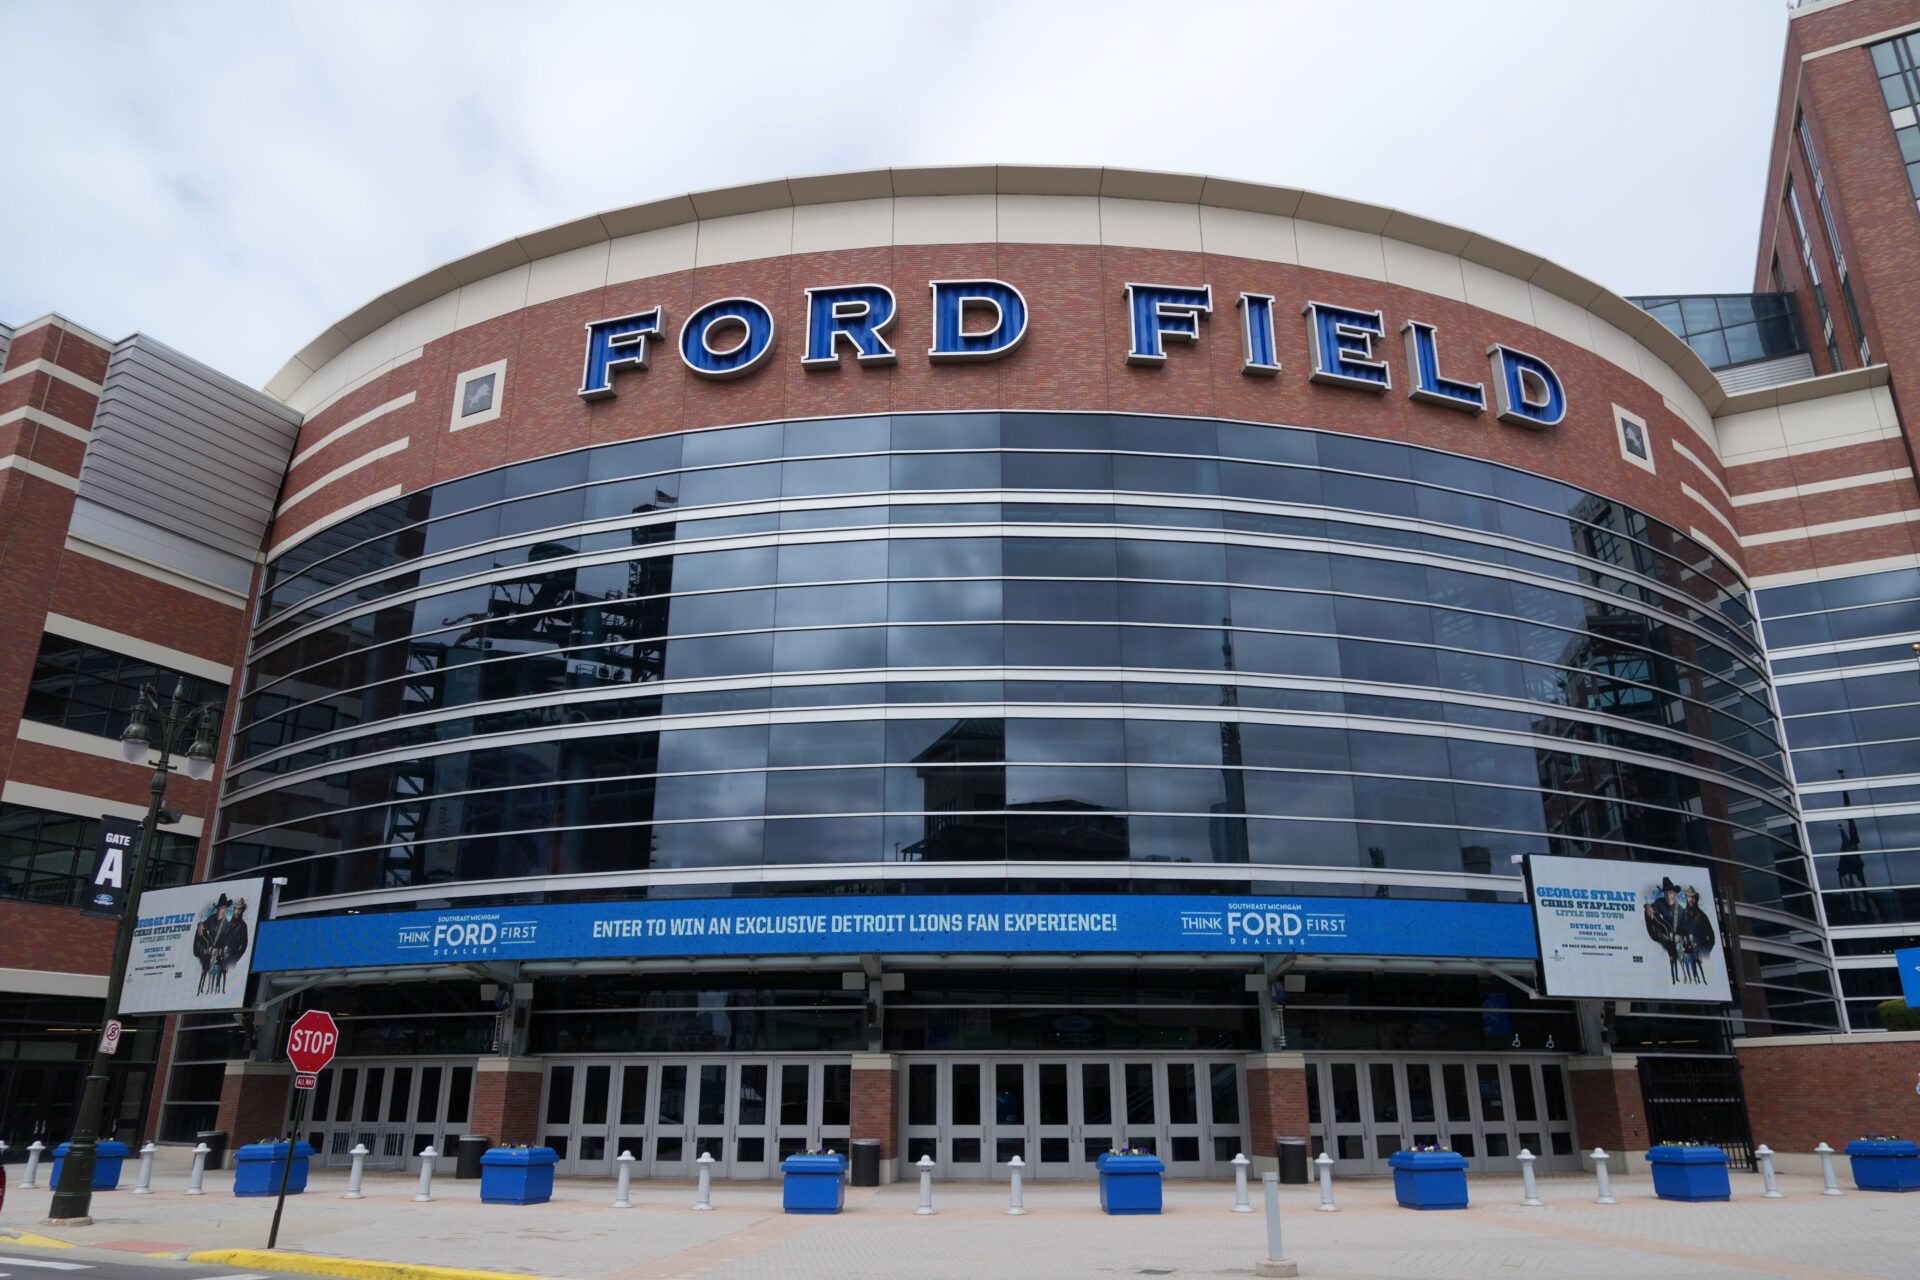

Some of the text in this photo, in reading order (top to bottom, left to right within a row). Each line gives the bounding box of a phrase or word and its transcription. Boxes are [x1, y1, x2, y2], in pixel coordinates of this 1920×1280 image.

[577, 279, 1567, 429] FORD FIELD
[105, 832, 132, 847] GATE
[94, 847, 123, 889] A
[1536, 887, 1637, 902] GEORGE STRAIT
[1228, 903, 1302, 911] SOUTHEAST MICHIGAN
[1541, 899, 1636, 912] CHRIS STAPLETON
[165, 913, 196, 925] STRAIT
[438, 915, 470, 923] SOUTHEAST
[1555, 910, 1585, 918] LITTLE
[1601, 911, 1625, 920] TOWN
[593, 913, 1118, 938] ENTER TO WIN AN EXCLUSIVE DETROIT LIONS FAN EXPERIENCE!
[1181, 912, 1346, 936] THINK FORD FIRST
[1569, 923, 1604, 931] DETROIT,
[134, 924, 192, 938] CHRIS STAPLETON
[398, 922, 538, 947] THINK FORD FIRST
[1230, 938, 1305, 946] DEALERS
[434, 946, 497, 956] DEALERS
[292, 1029, 334, 1054] STOP
[297, 1078, 305, 1086] ALL
